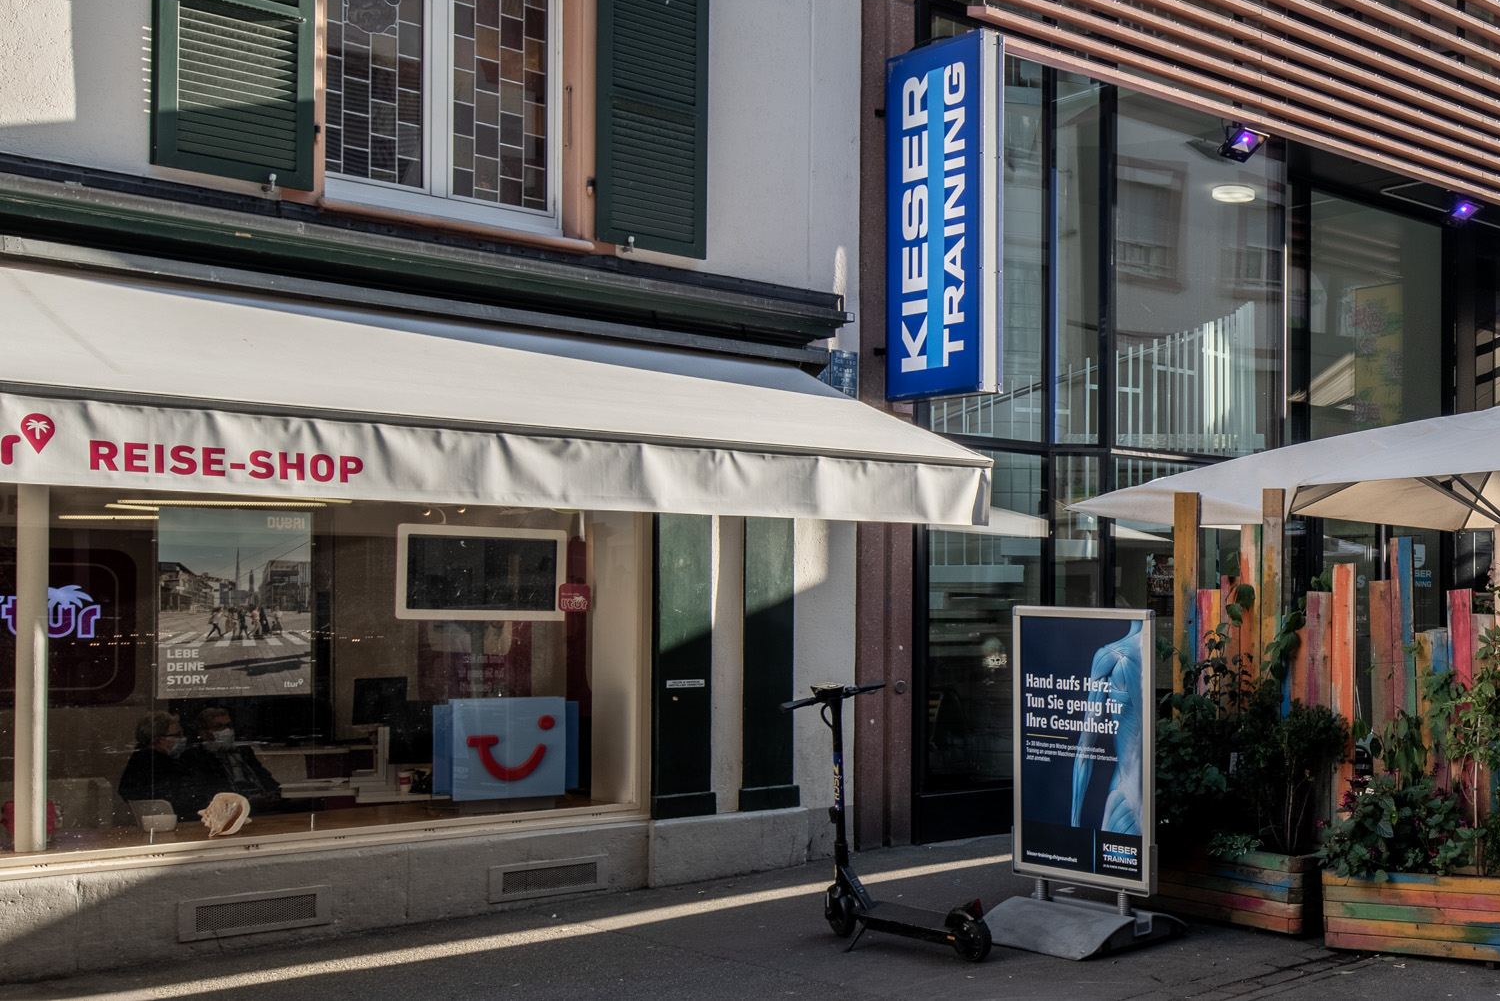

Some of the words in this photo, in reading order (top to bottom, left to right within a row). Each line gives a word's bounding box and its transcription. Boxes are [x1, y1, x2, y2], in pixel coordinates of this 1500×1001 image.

[943, 61, 967, 367] TRAINING
[901, 75, 929, 374] KIESER
[89, 440, 364, 483] REISE-SHOP
[267, 516, 305, 529] DUBAI
[166, 649, 200, 659] LEBE
[166, 662, 205, 672] DEINE
[166, 674, 209, 685] STORY
[1026, 673, 1053, 689] Hand
[1056, 675, 1080, 691] aufs
[1083, 677, 1112, 693] Herz:
[1025, 693, 1045, 708] Tun
[1047, 694, 1064, 709] Sie
[1067, 699, 1102, 716] genug
[1105, 698, 1123, 714] für
[1026, 712, 1047, 728] Ihre
[1050, 715, 1119, 734] Gesundheit?
[1102, 843, 1137, 856] KIESER
[1102, 854, 1138, 866] TRAINING
